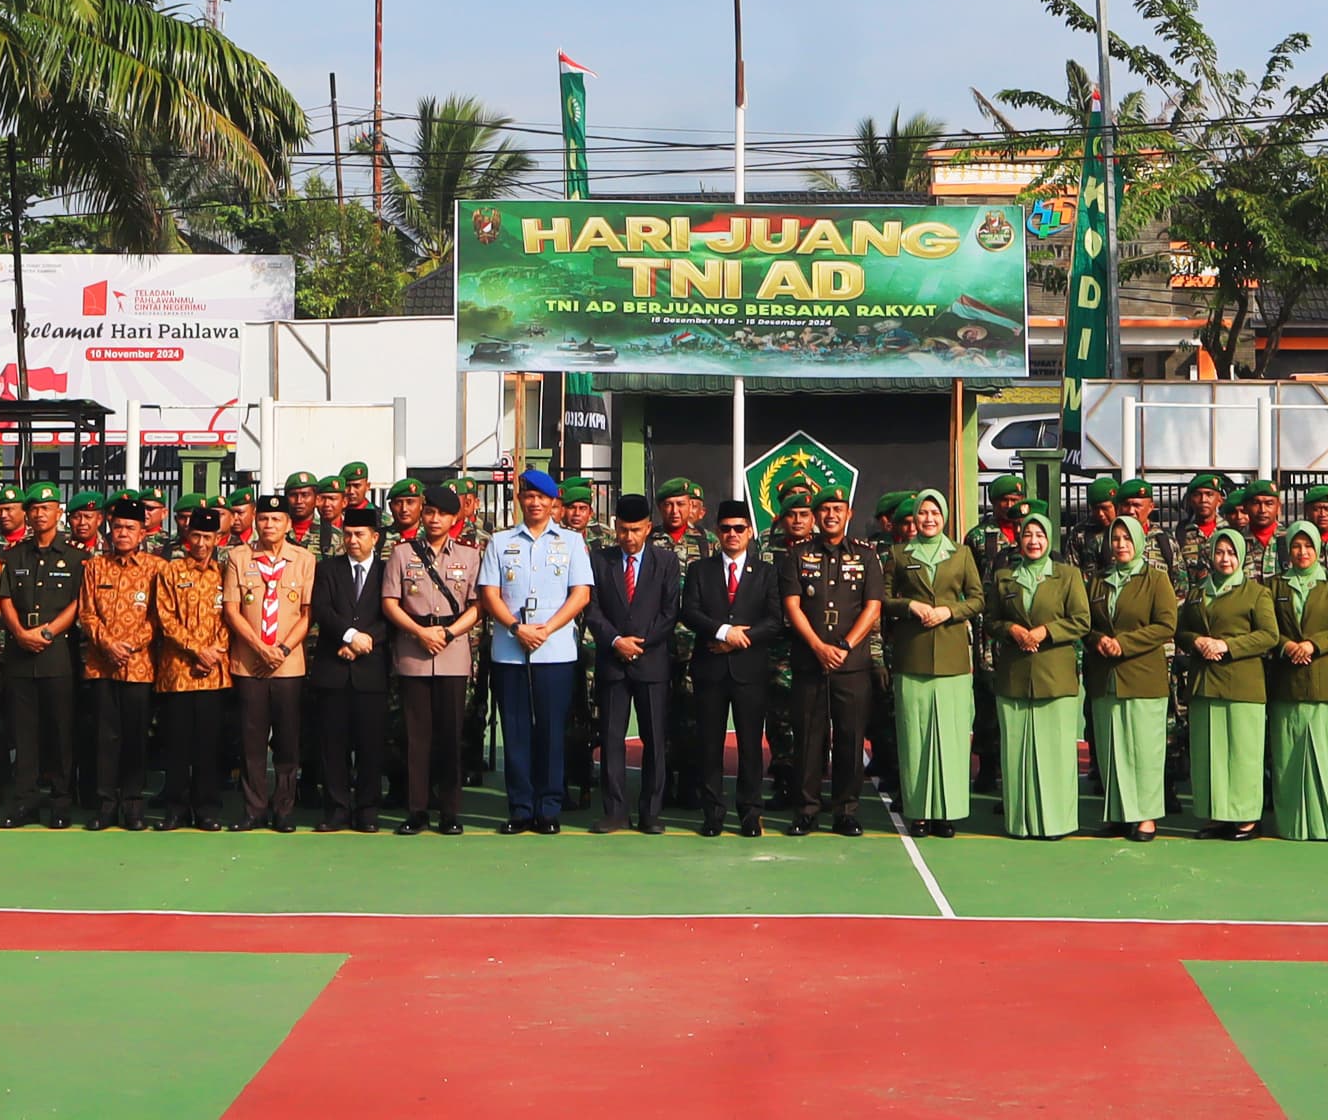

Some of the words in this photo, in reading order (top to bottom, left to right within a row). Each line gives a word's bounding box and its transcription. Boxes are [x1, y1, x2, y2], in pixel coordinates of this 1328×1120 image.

[521, 216, 690, 254] HARI
[705, 217, 961, 259] JUANG
[617, 257, 742, 299] TNI
[756, 260, 865, 301] AD
[135, 289, 175, 297] TELADANI
[163, 304, 207, 312] NEGERIMU
[545, 300, 579, 312] TNI
[585, 300, 616, 313] AD
[623, 301, 738, 315] BERJUANG
[745, 303, 850, 317] BERSAMA
[856, 304, 937, 317] RAKYAT
[111, 322, 153, 339] Hari
[90, 350, 102, 358] 10
[104, 350, 154, 358] November
[157, 350, 180, 358] 2024
